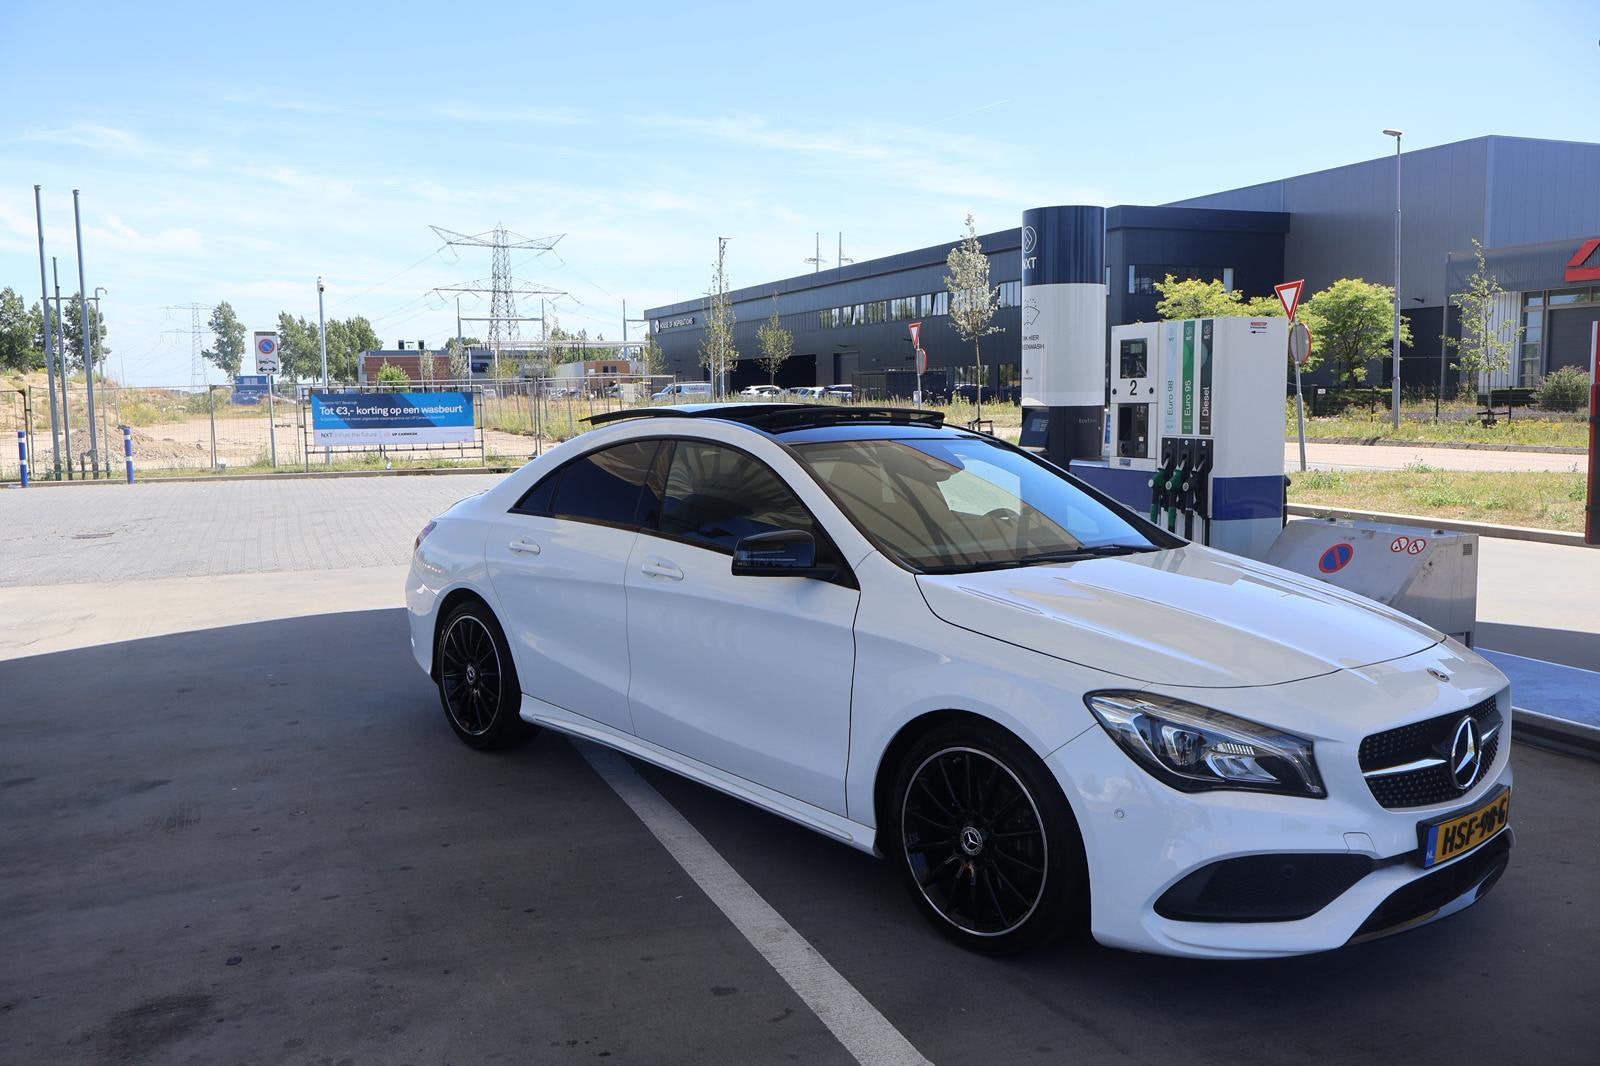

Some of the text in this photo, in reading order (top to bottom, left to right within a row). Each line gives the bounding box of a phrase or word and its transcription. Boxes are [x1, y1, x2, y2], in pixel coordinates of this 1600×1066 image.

[1129, 380, 1137, 396] 2
[1184, 380, 1191, 393] 95
[1201, 386, 1210, 416] Diesel
[319, 406, 335, 415] Tot
[336, 406, 354, 417] €3,-
[356, 405, 389, 417] korting
[389, 407, 402, 416] op
[421, 405, 463, 414] wasbeurt
